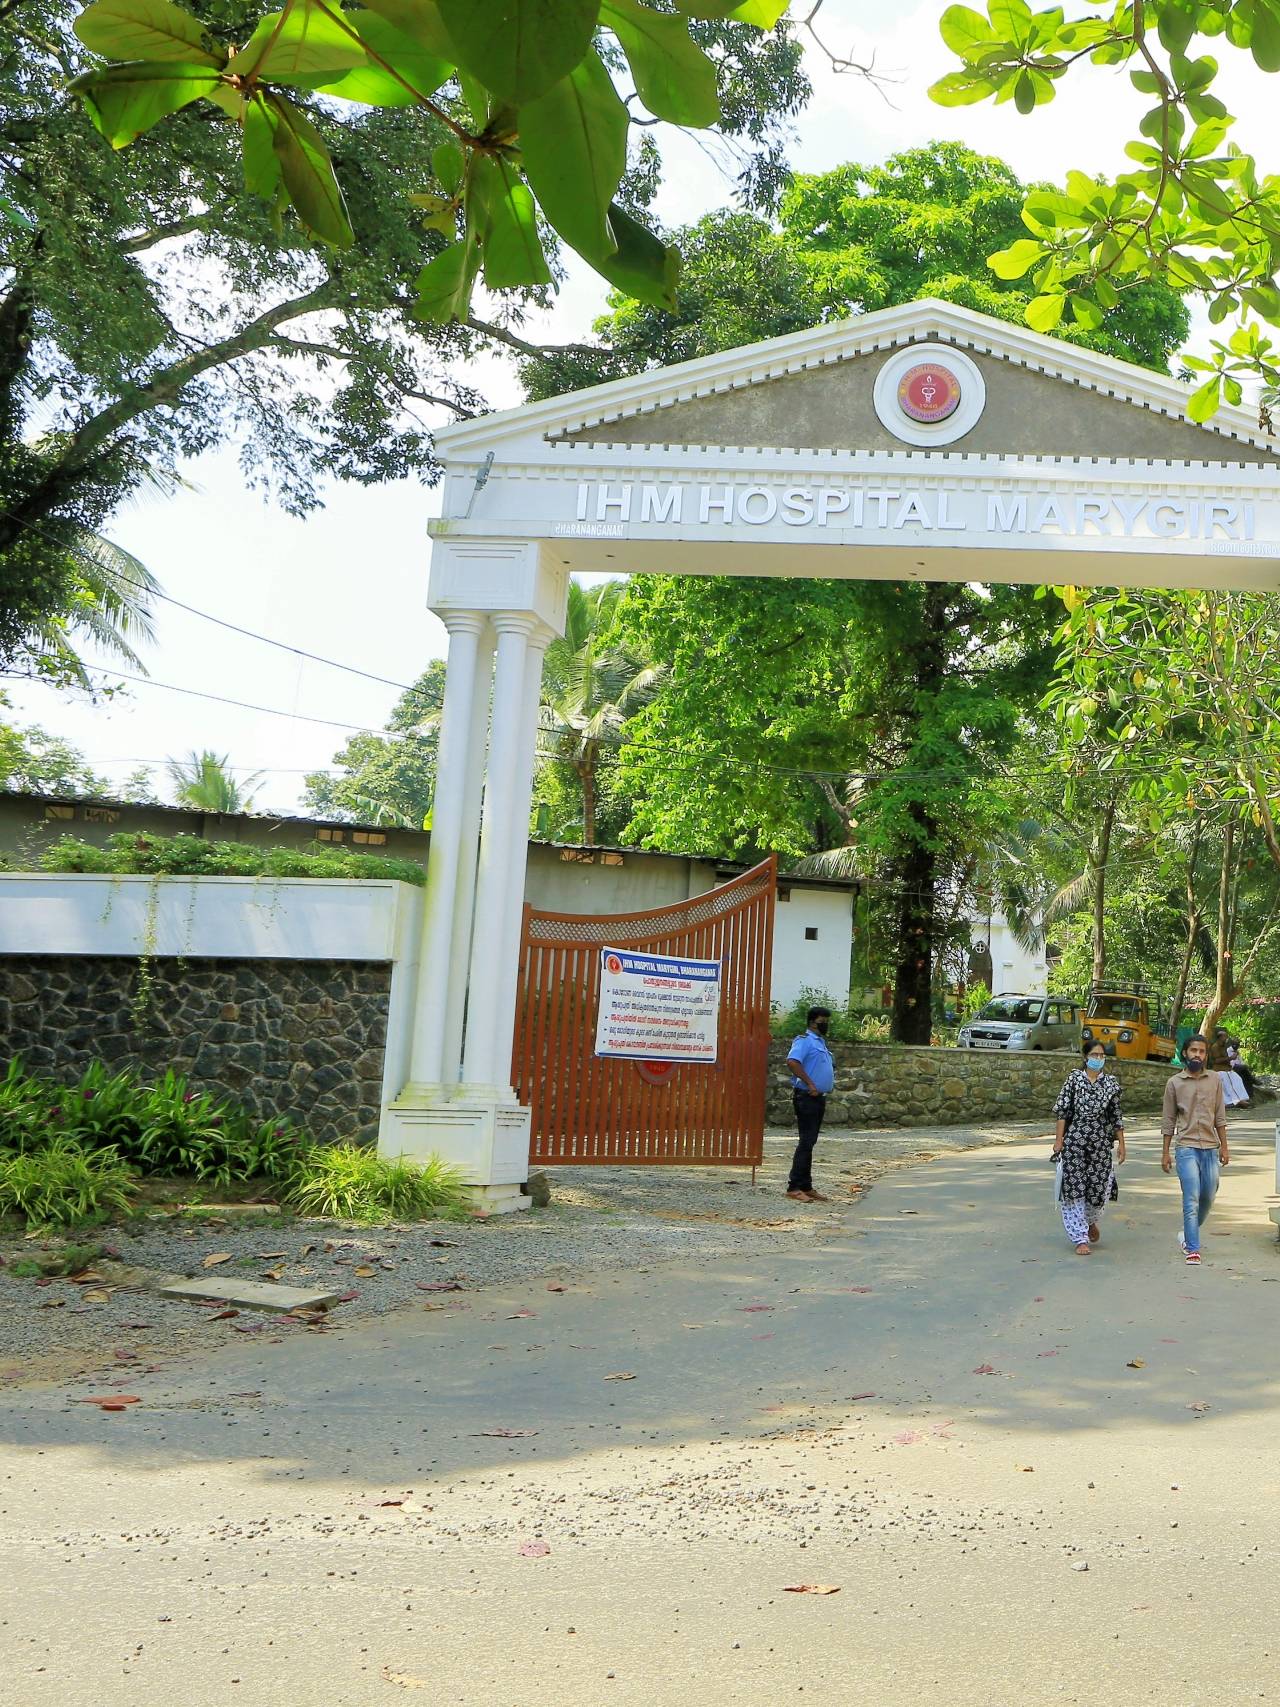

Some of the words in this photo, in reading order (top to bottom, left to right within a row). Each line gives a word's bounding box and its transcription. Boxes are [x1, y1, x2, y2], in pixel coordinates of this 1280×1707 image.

[576, 483, 683, 523] IHM
[699, 486, 966, 531] HOSPITAL
[987, 494, 1256, 541] MARYGIRI
